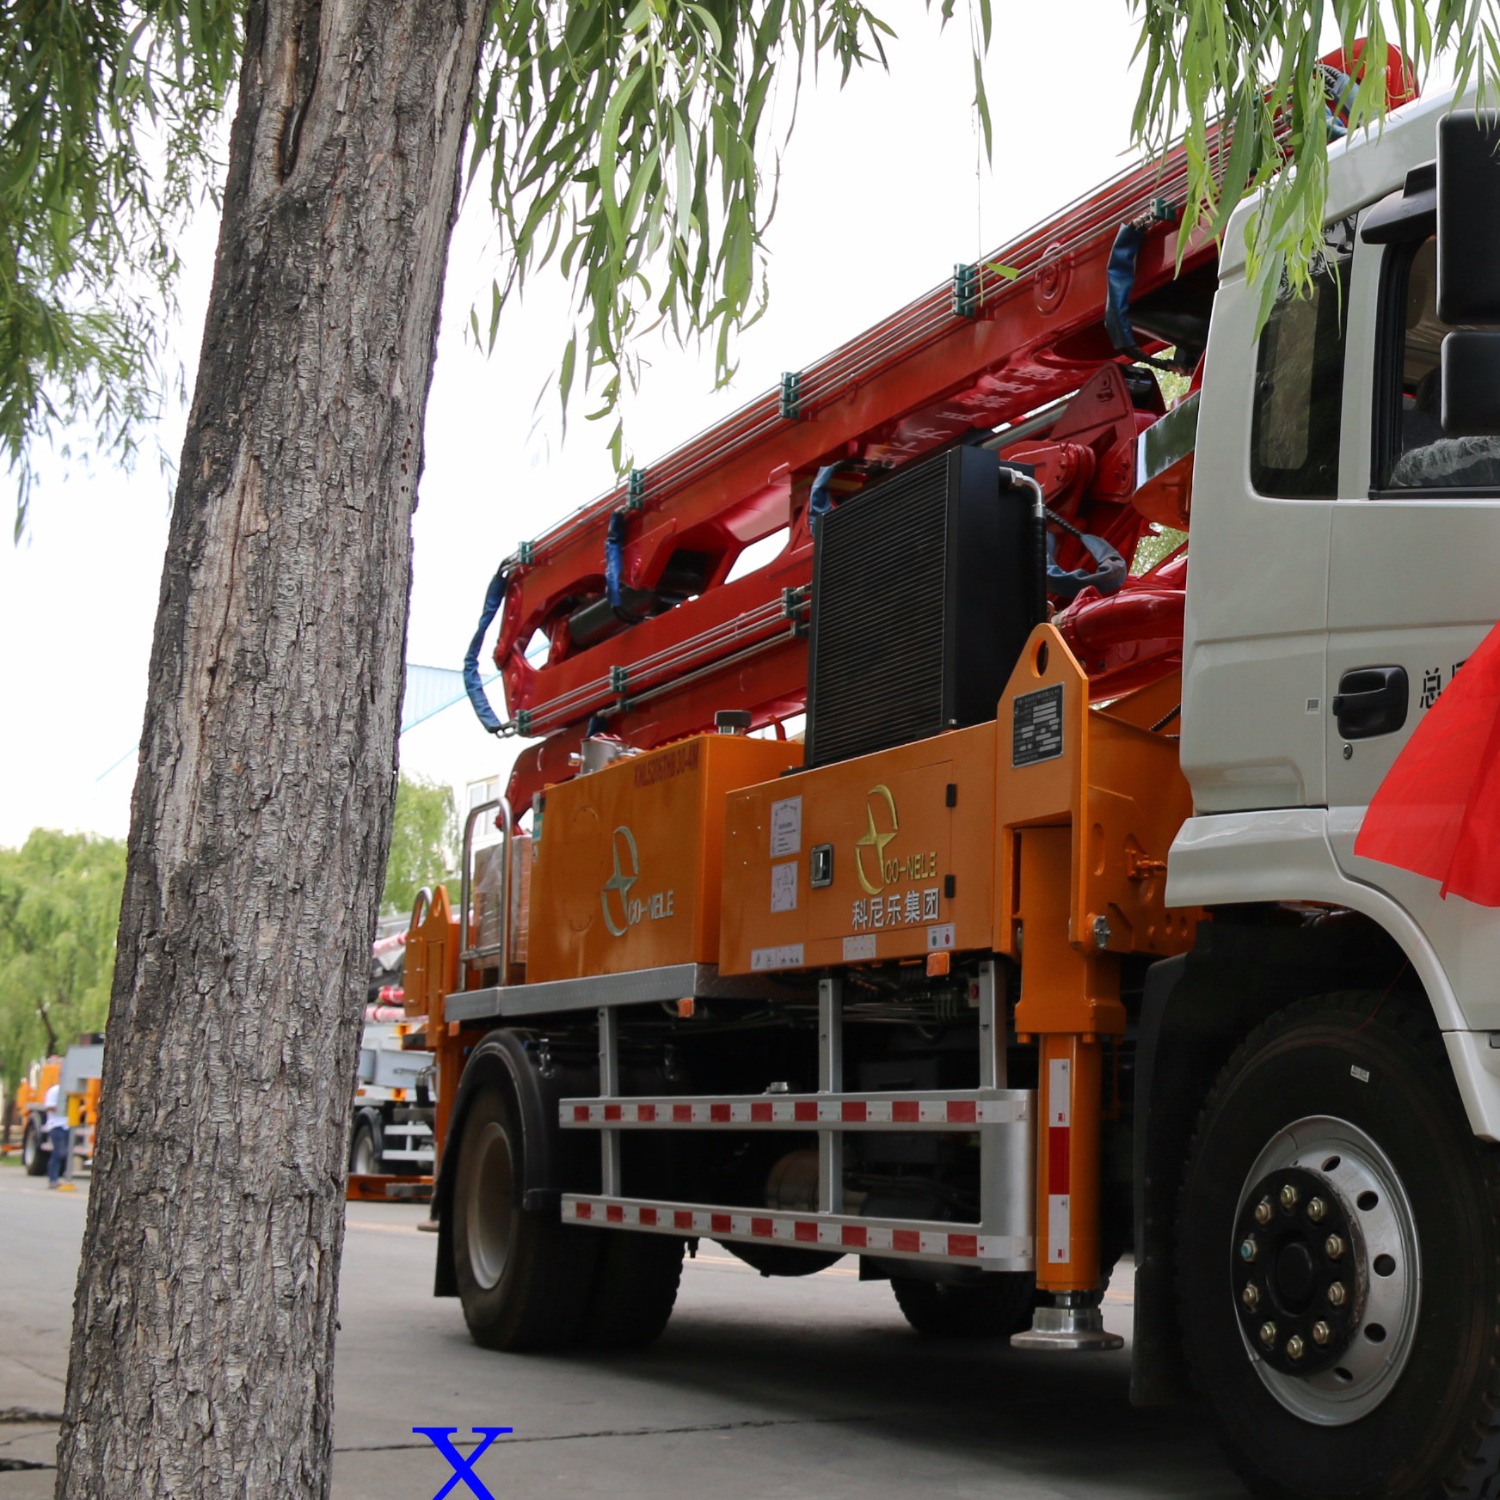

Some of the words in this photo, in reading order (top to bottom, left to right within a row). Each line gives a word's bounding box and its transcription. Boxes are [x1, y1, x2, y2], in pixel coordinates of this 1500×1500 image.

[884, 851, 937, 884] CO-NELE
[852, 887, 940, 931] 科尼乐集团
